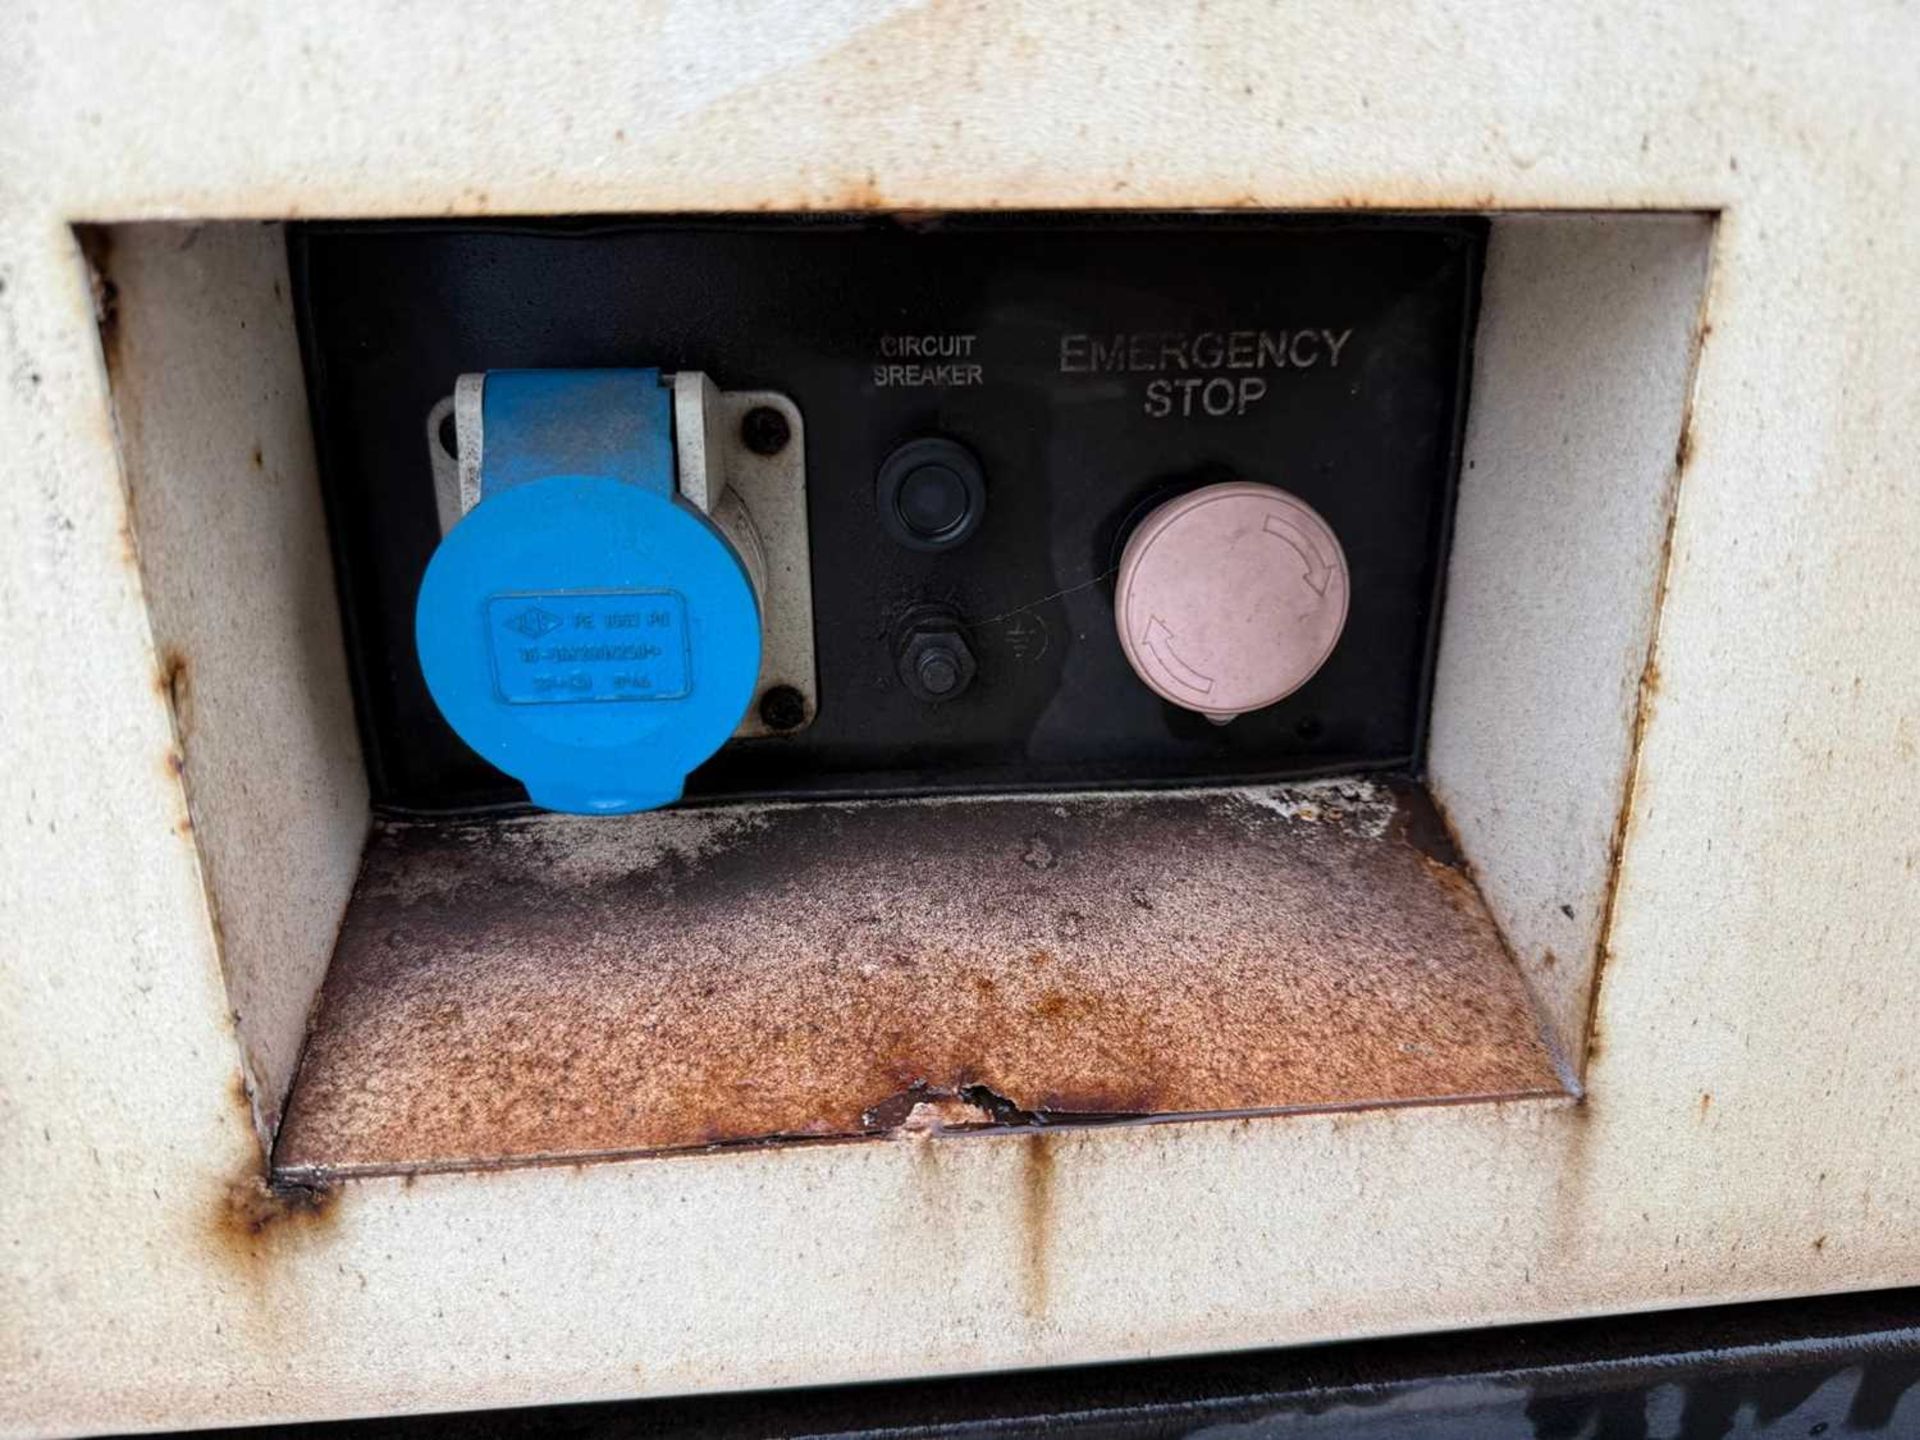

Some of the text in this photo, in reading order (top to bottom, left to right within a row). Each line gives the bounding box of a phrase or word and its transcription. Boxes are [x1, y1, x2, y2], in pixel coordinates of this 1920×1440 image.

[880, 334, 977, 357] CIRCUIT
[1059, 328, 1353, 373] EMERGENCY
[873, 364, 984, 387] BREAKER
[1144, 377, 1268, 418] STOP
